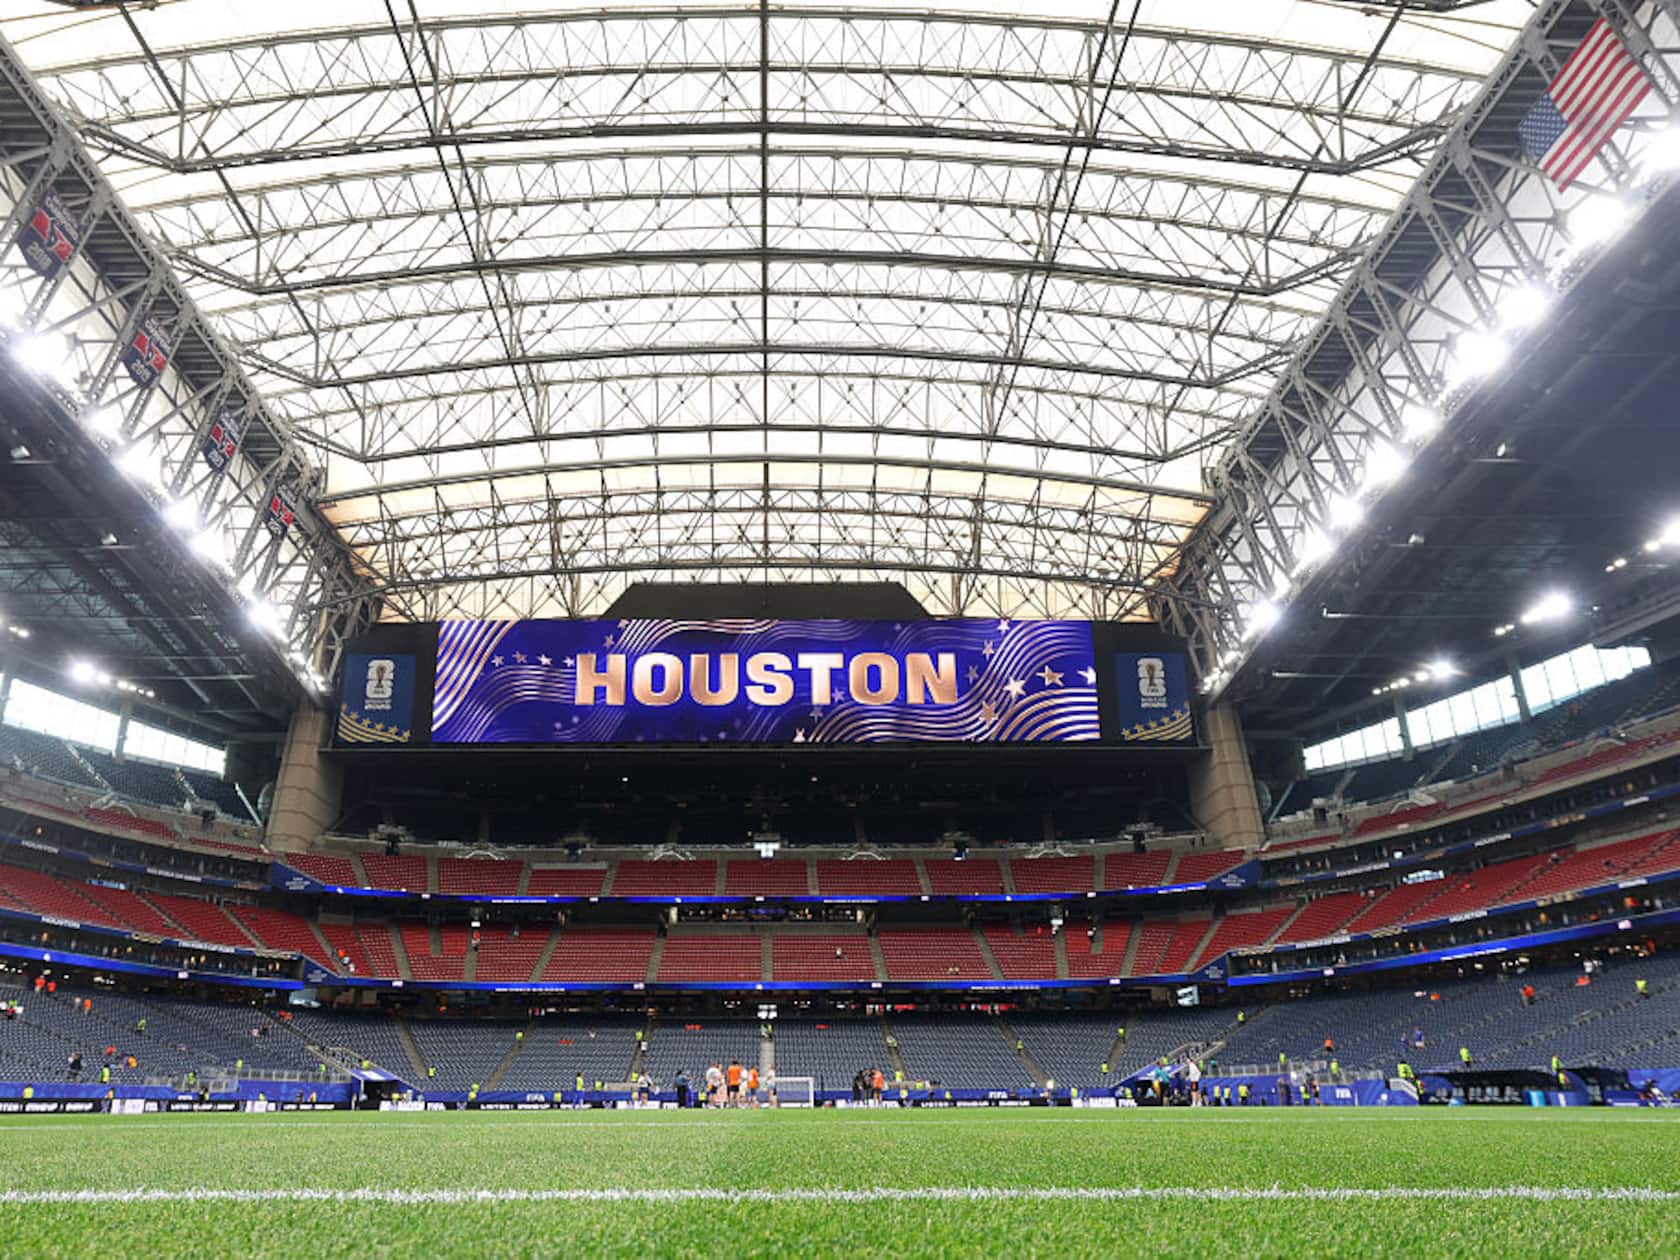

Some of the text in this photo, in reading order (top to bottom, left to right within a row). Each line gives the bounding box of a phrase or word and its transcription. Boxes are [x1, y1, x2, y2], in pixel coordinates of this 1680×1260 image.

[574, 652, 958, 707] HOUSTON
[526, 1093, 545, 1102] FIFA
[989, 1091, 1008, 1099] FIFA
